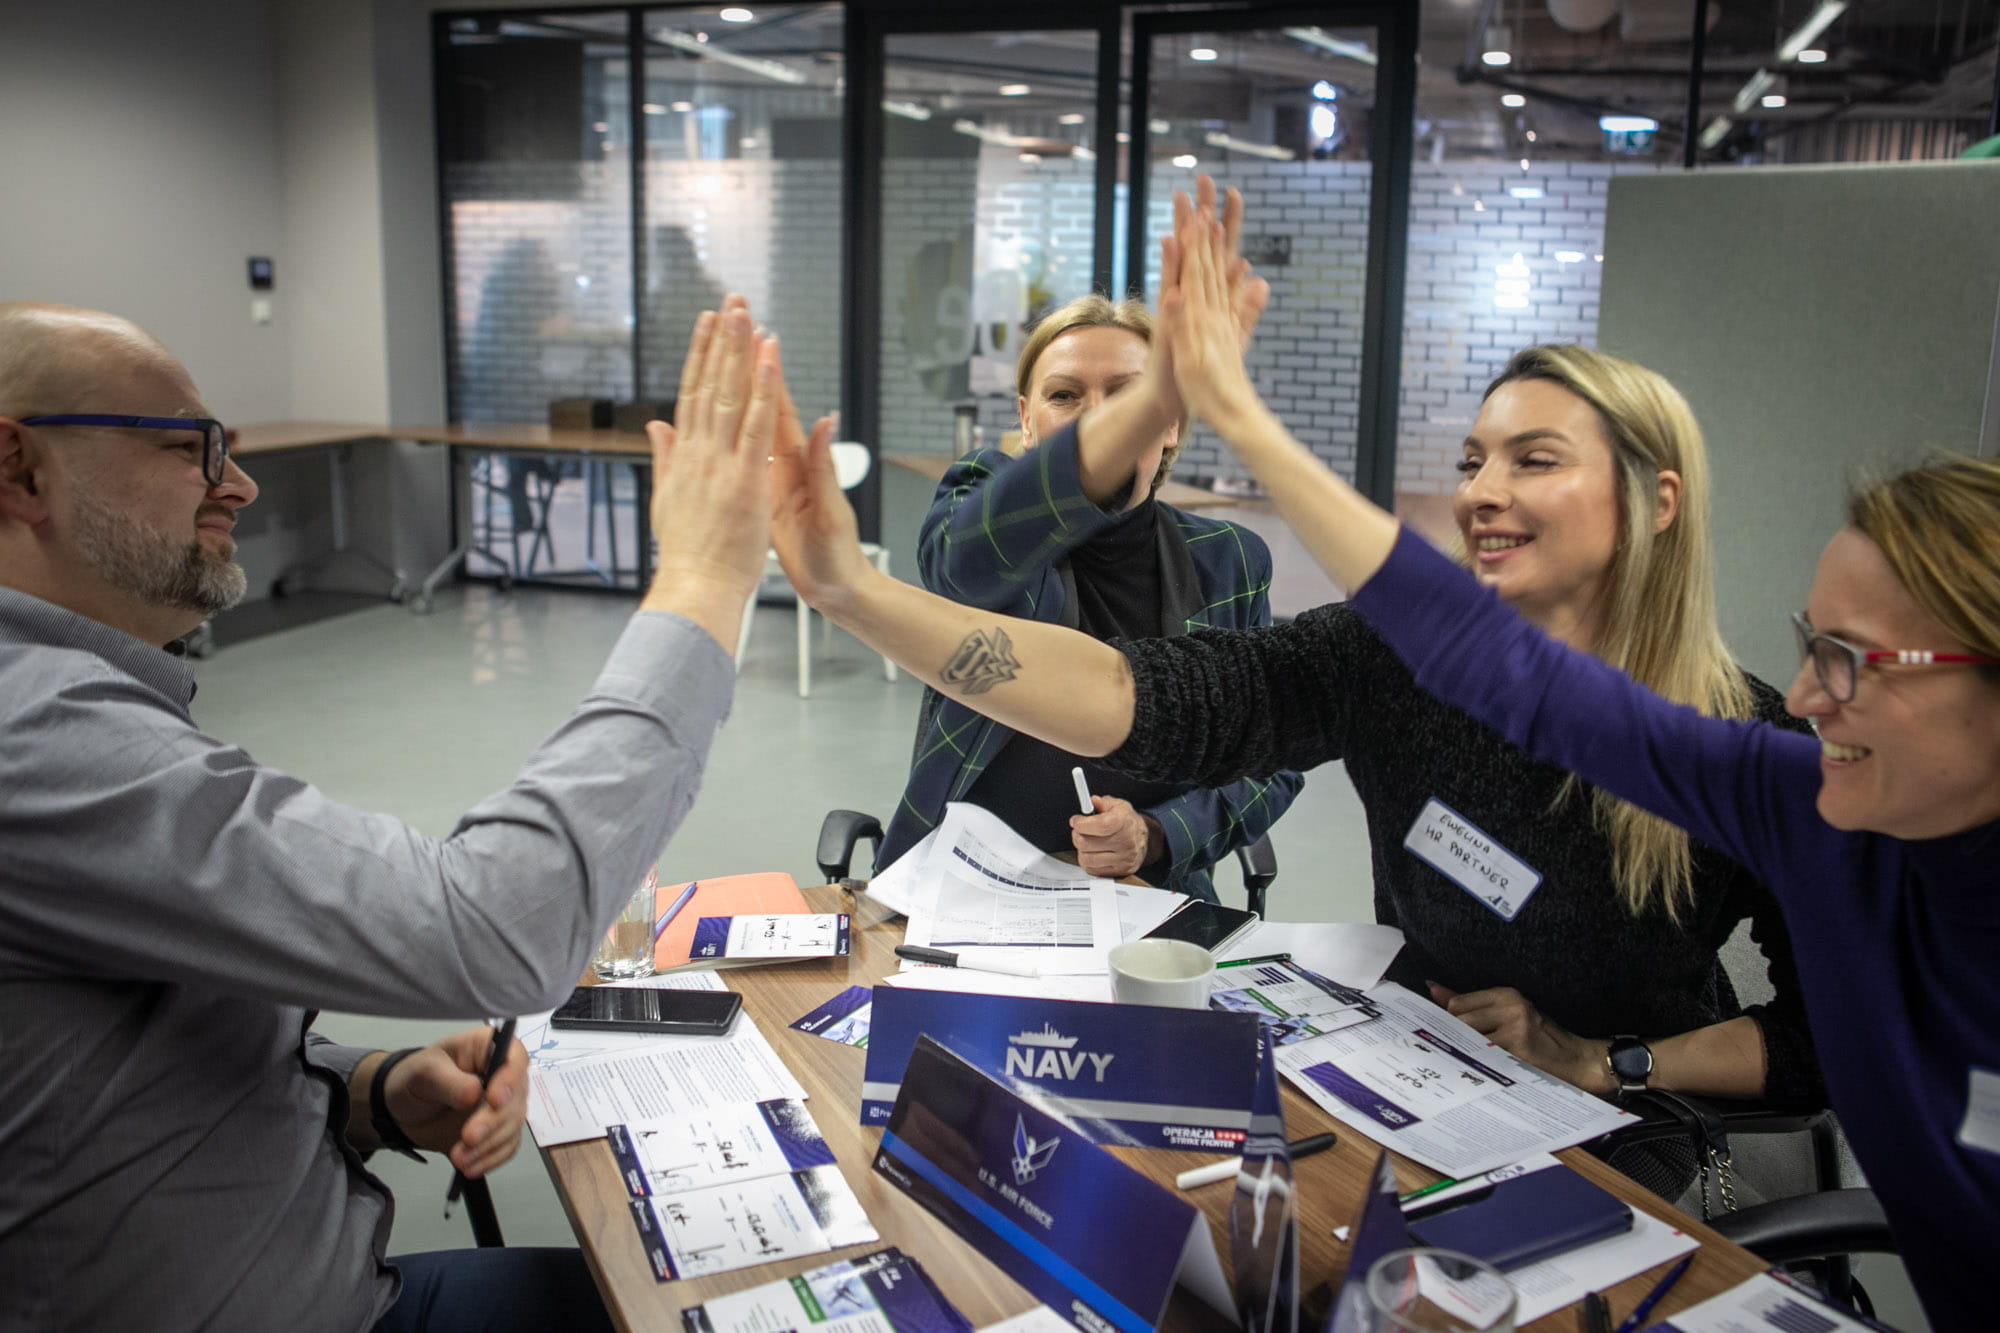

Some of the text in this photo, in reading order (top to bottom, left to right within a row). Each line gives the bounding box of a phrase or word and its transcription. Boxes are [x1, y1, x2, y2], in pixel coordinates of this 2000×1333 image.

[1439, 814, 1490, 854] EWELINA
[1424, 824, 1509, 890] HR PARTNER
[1005, 1046, 1115, 1082] NAVY
[1162, 1126, 1215, 1139] OPERACJA
[1170, 1137, 1235, 1148] STRIKE FIGHTER
[999, 1183, 1019, 1205] AIR
[1018, 1195, 1054, 1230] FORCE
